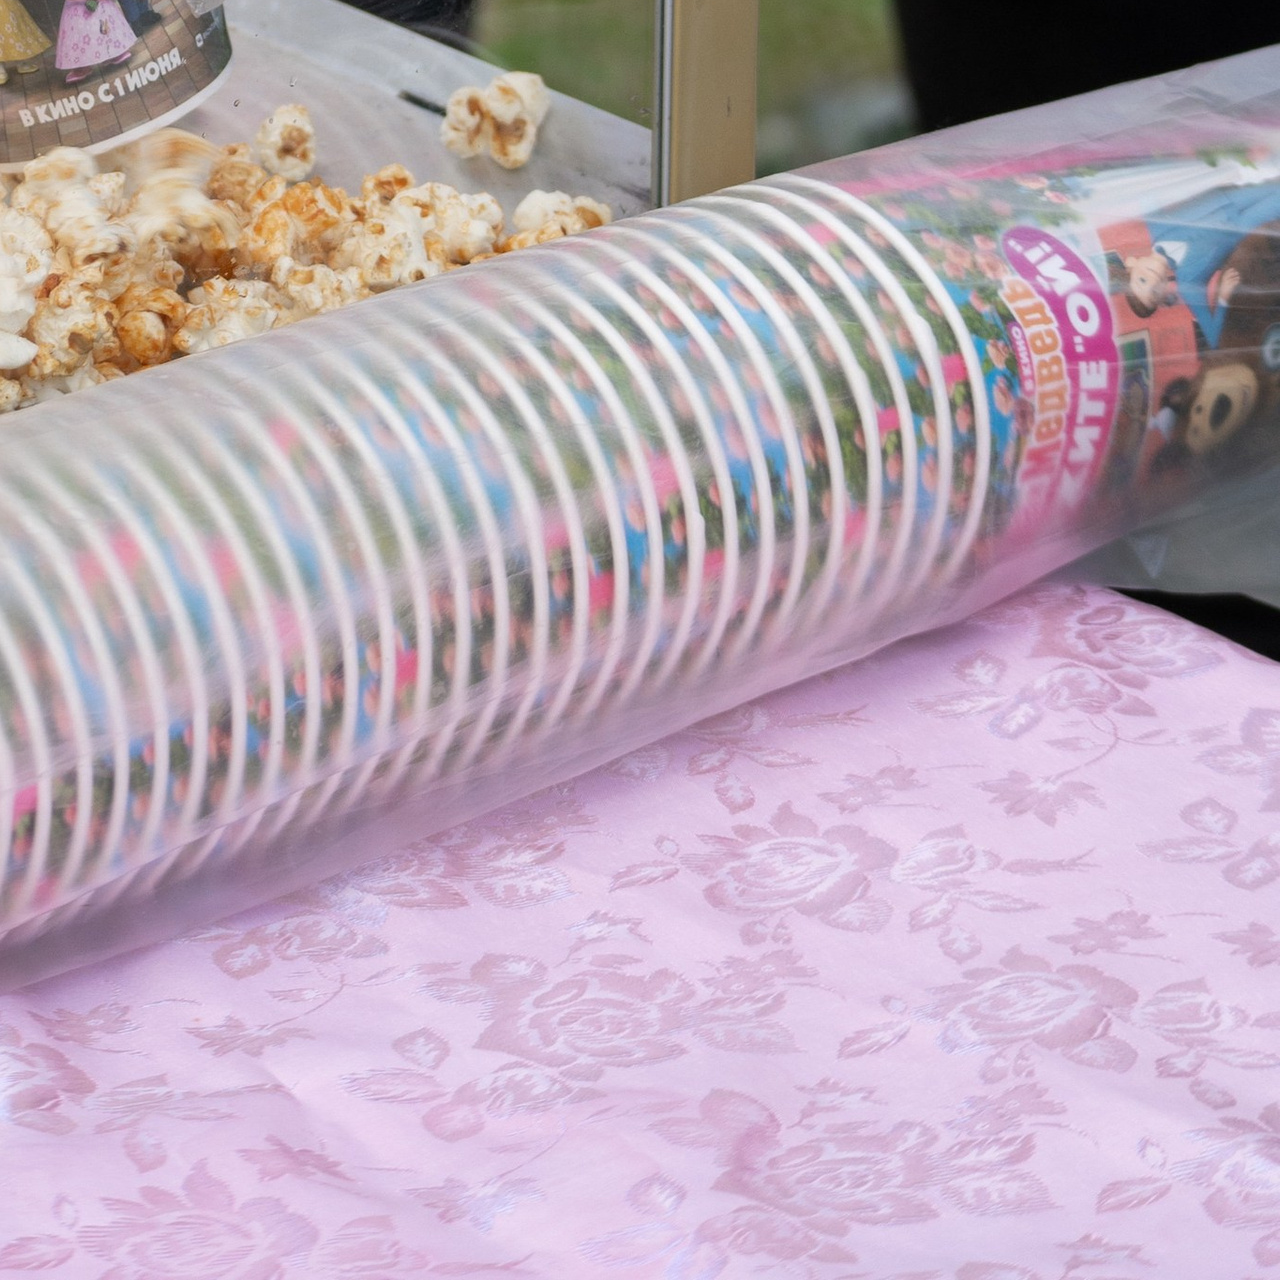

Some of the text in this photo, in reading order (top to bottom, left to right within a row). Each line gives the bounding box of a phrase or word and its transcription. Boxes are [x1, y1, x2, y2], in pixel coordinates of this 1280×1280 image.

[19, 108, 35, 128] В
[35, 91, 95, 124] КИНО
[114, 78, 125, 96] 1
[125, 47, 181, 92] ИЮНЯ
